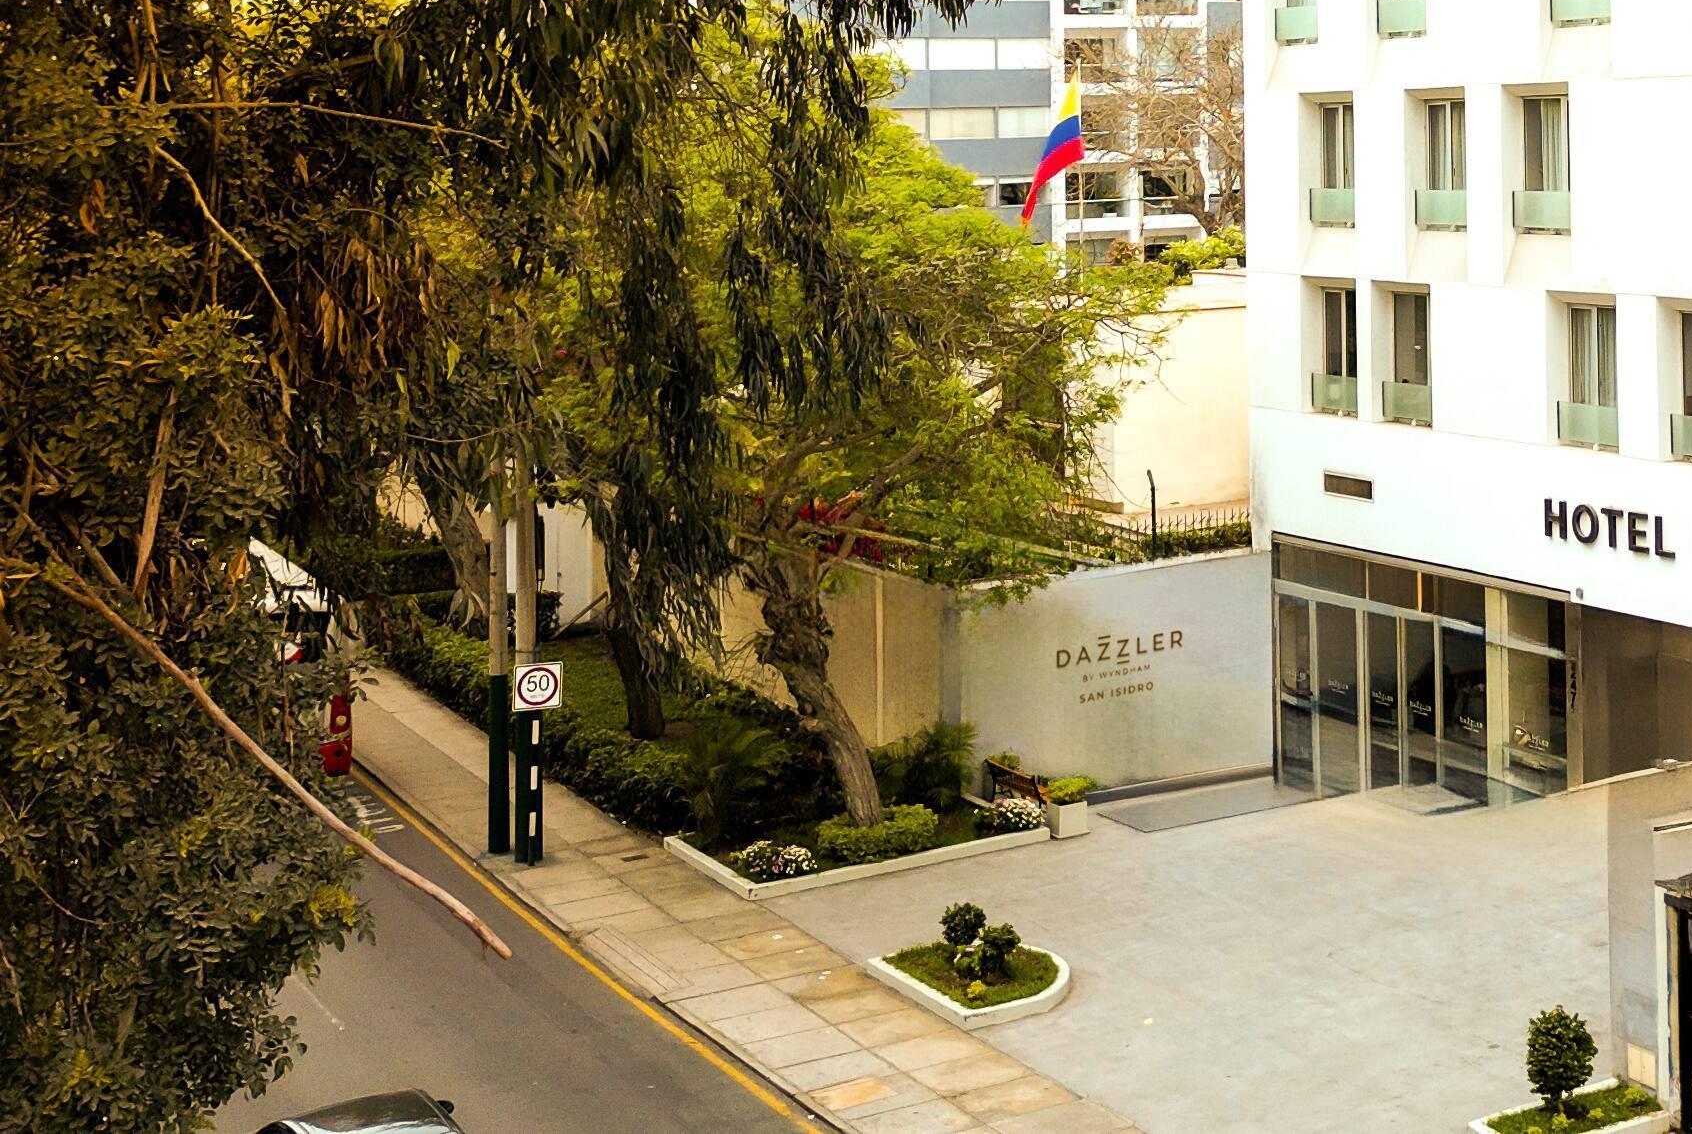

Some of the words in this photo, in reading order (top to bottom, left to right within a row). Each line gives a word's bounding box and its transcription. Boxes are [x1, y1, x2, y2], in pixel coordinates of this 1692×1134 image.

[1543, 498, 1676, 559] HOTEL
[1056, 630, 1183, 668] DAZZLER
[527, 674, 550, 692] 50
[1082, 674, 1095, 682] BY
[1099, 664, 1151, 679] WYNDHAM
[1079, 690, 1104, 704] SAN
[1110, 681, 1154, 697] ISIDRO
